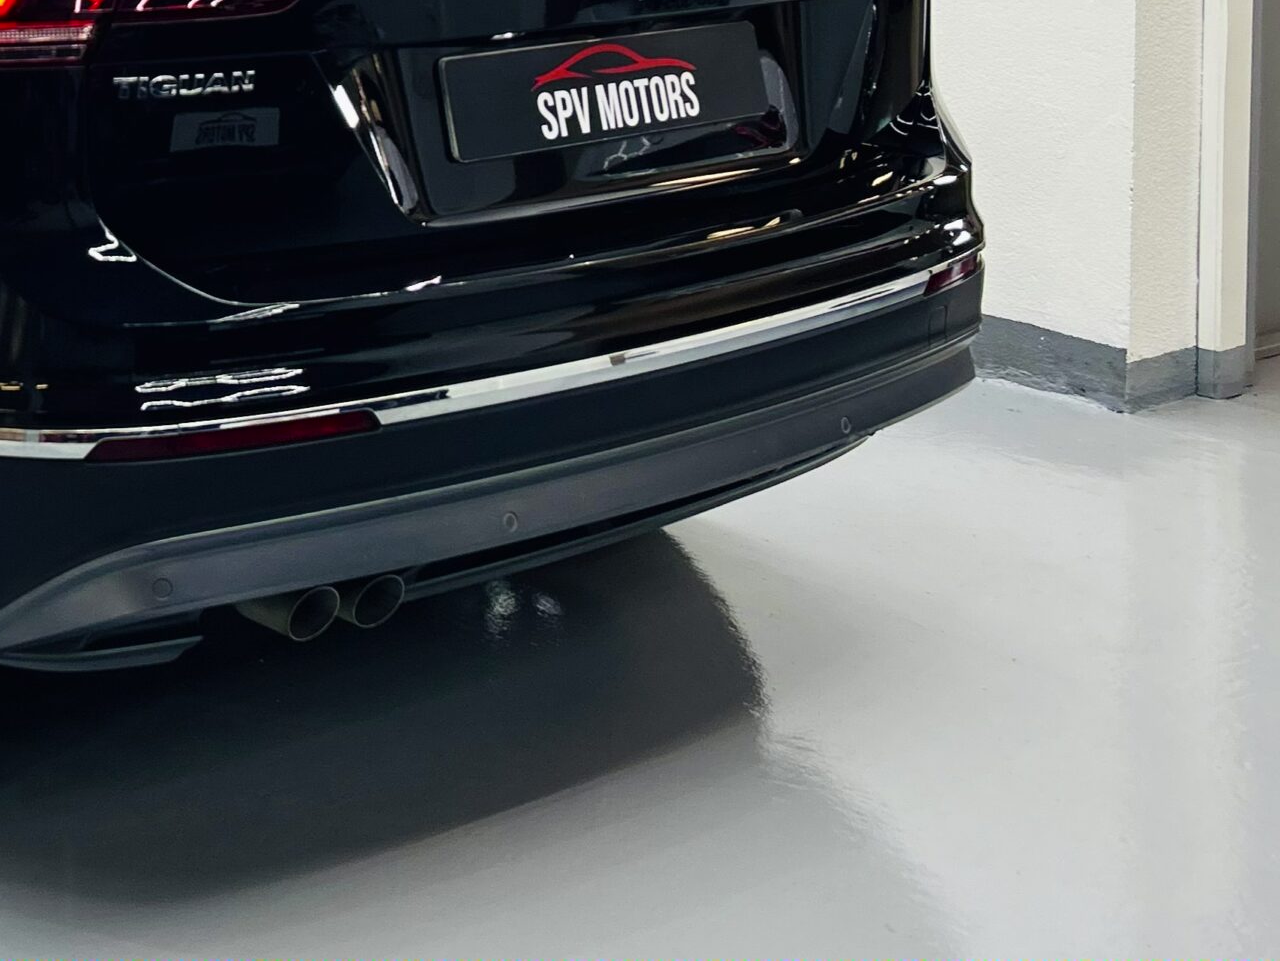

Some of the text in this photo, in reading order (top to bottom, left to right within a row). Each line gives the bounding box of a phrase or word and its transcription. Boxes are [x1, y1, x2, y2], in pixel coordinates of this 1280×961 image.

[113, 70, 256, 99] TIGUAN
[537, 71, 700, 139] SPV MOTORS
